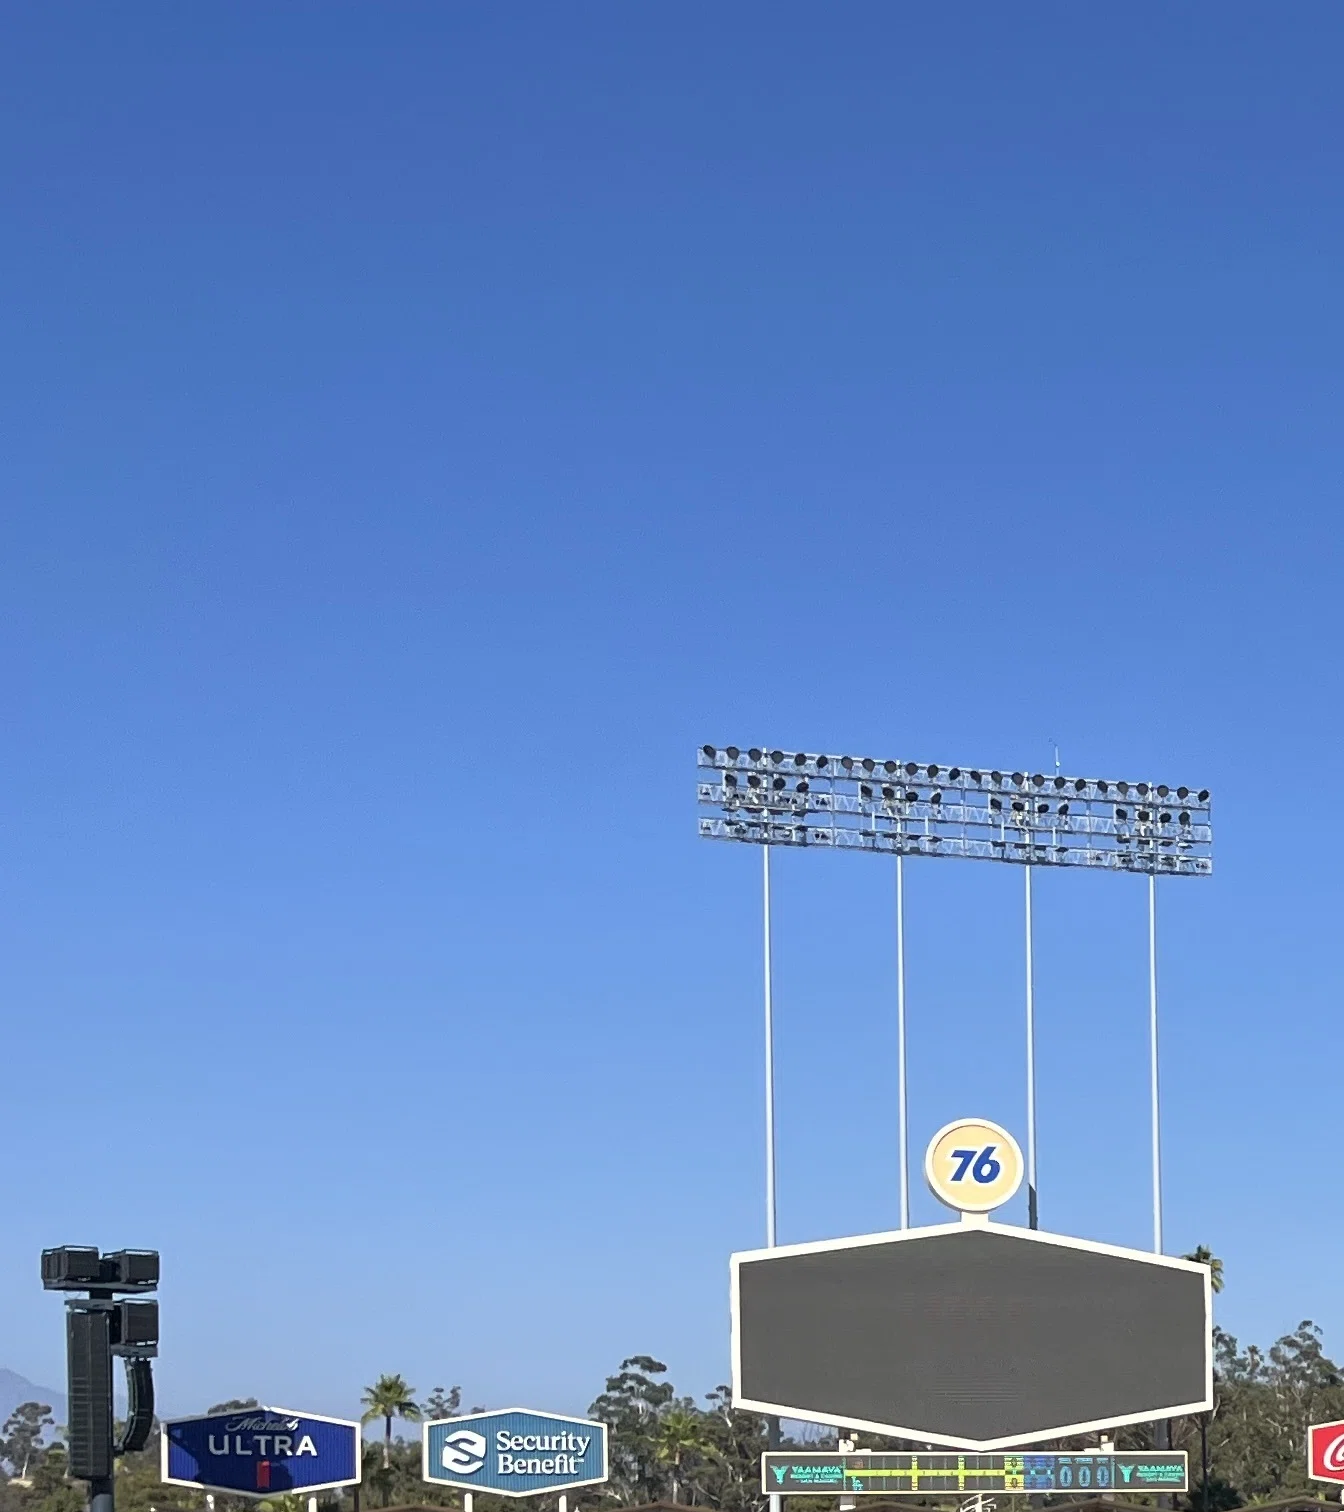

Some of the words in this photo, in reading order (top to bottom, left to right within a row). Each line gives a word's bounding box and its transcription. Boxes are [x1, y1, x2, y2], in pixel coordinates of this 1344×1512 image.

[950, 1146, 1001, 1184] 76
[208, 1434, 318, 1457] ULTRA
[496, 1430, 591, 1456] Security
[497, 1453, 579, 1475] Benefit
